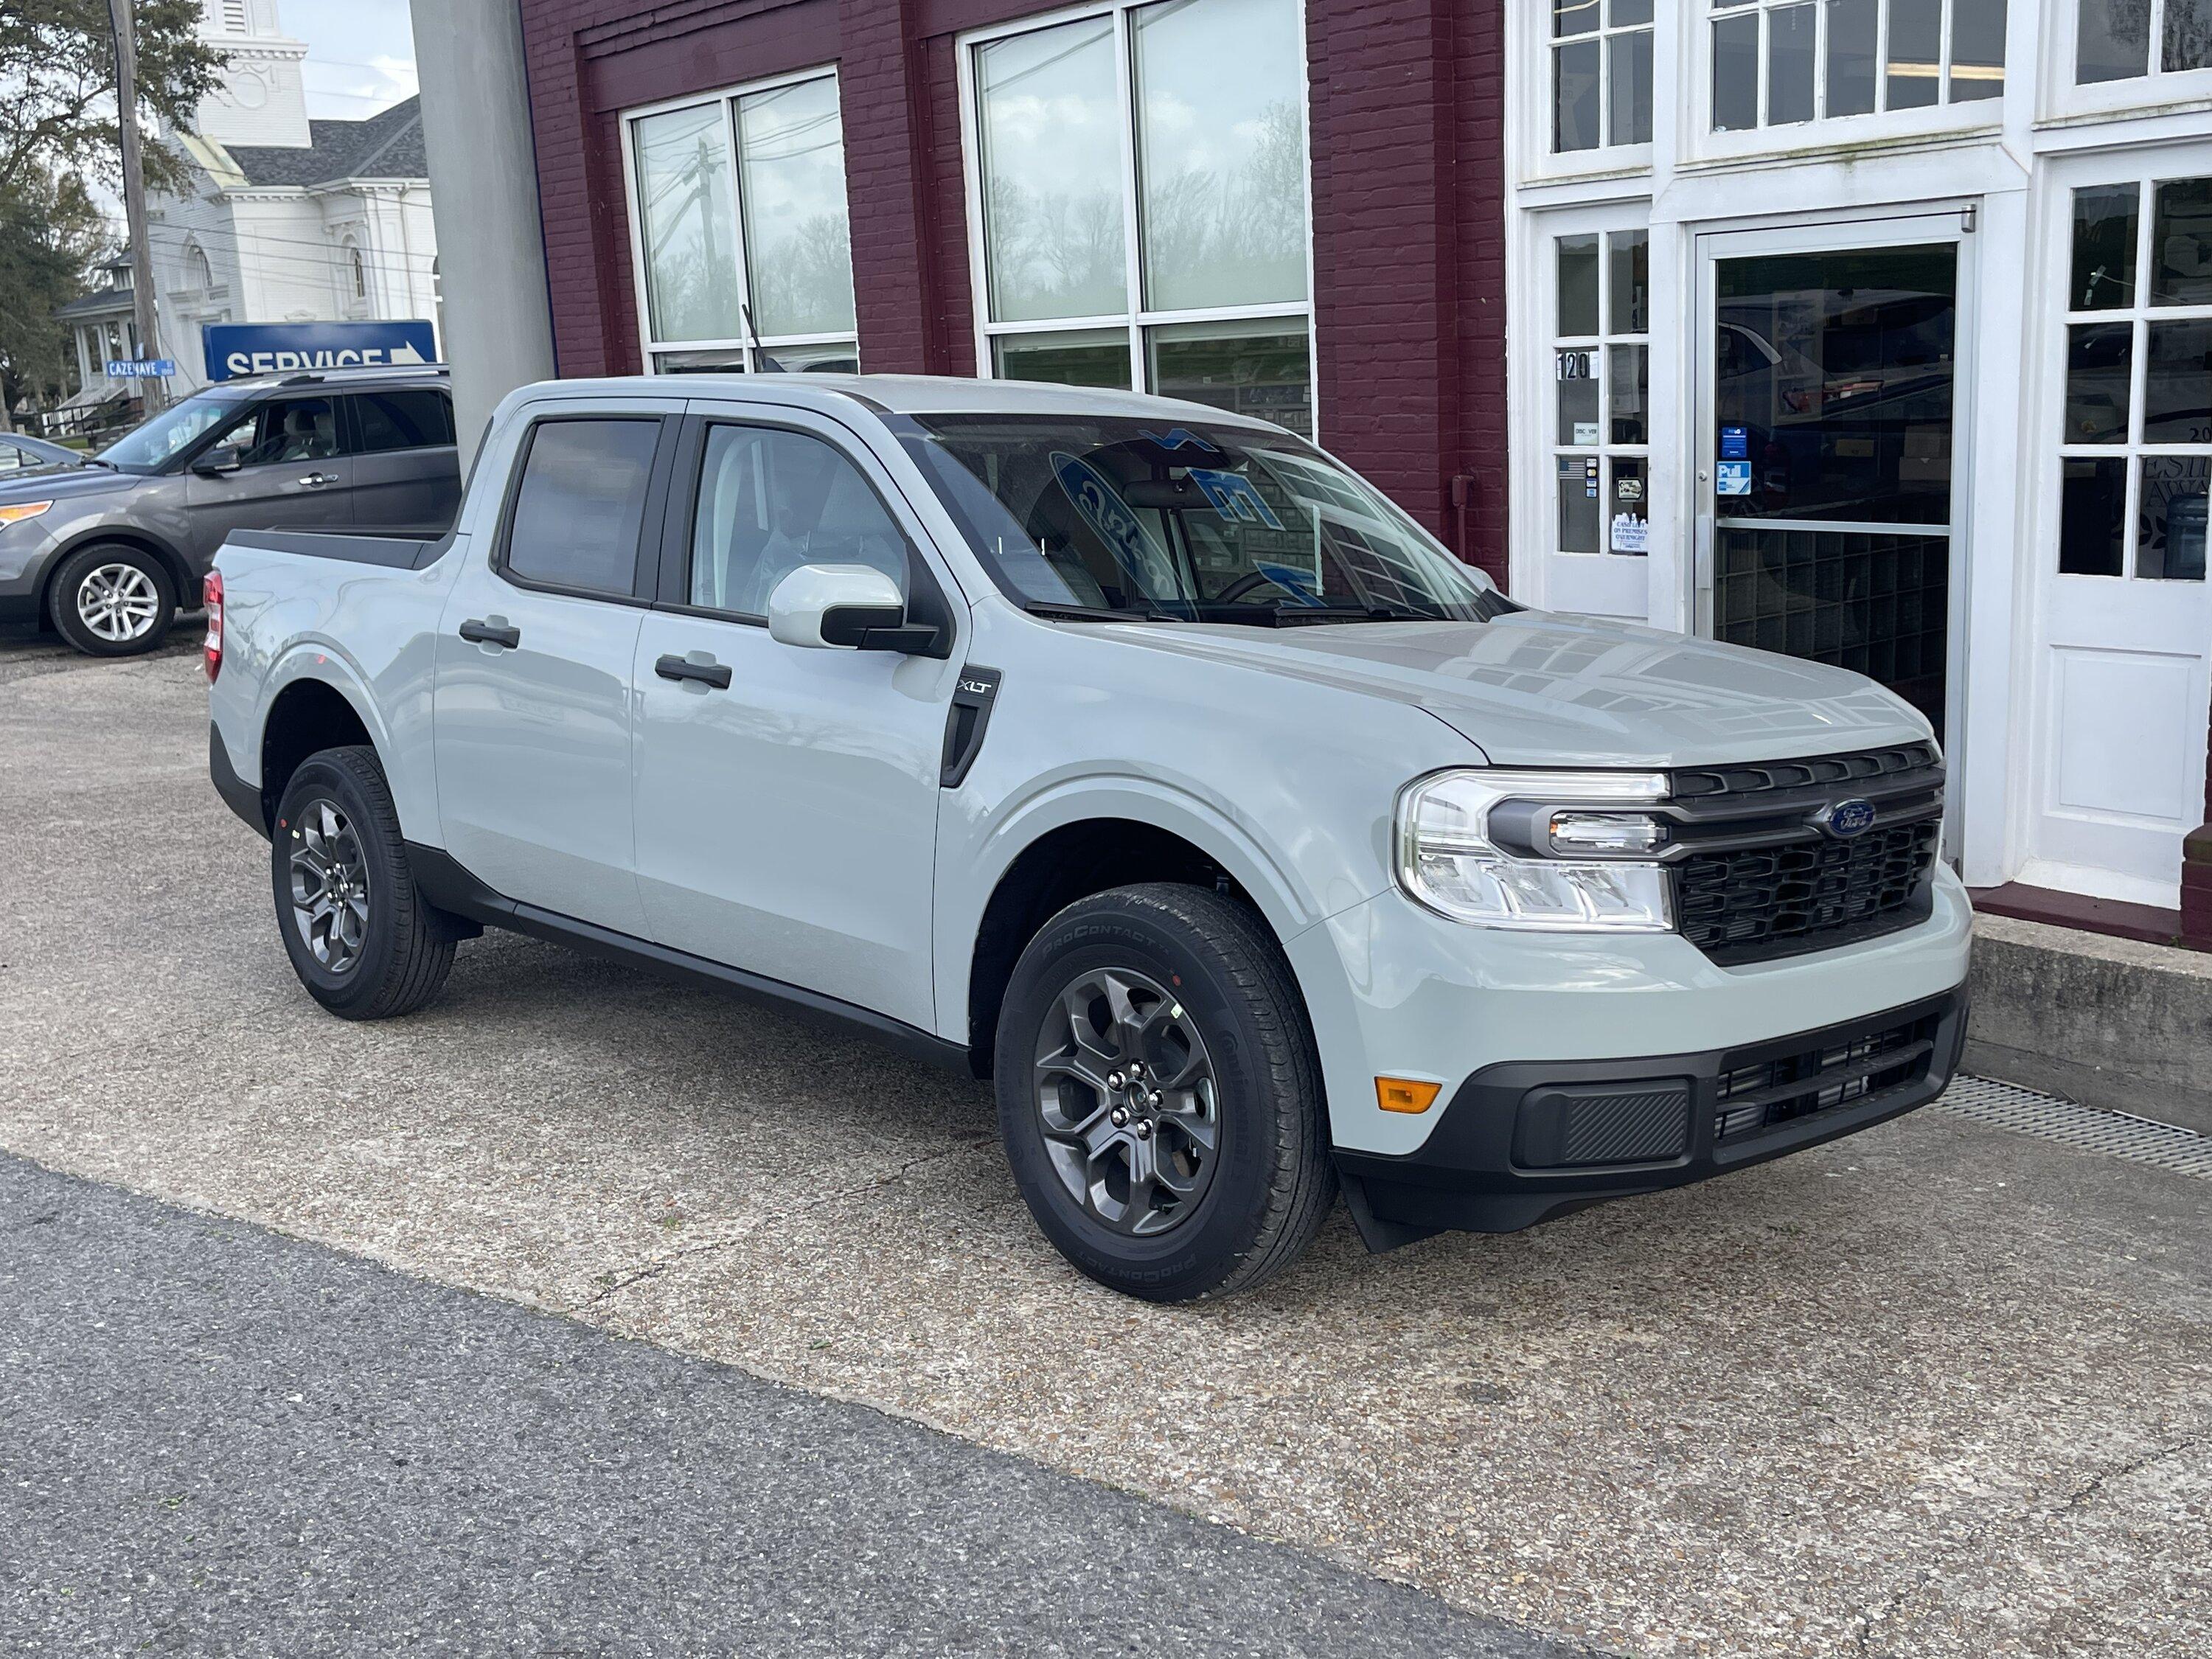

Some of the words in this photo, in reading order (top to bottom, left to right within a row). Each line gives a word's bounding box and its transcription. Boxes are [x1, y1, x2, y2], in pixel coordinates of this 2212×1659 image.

[1558, 353, 1587, 378] 120
[956, 679, 992, 693] XLT
[1840, 807, 1867, 829] Ford
